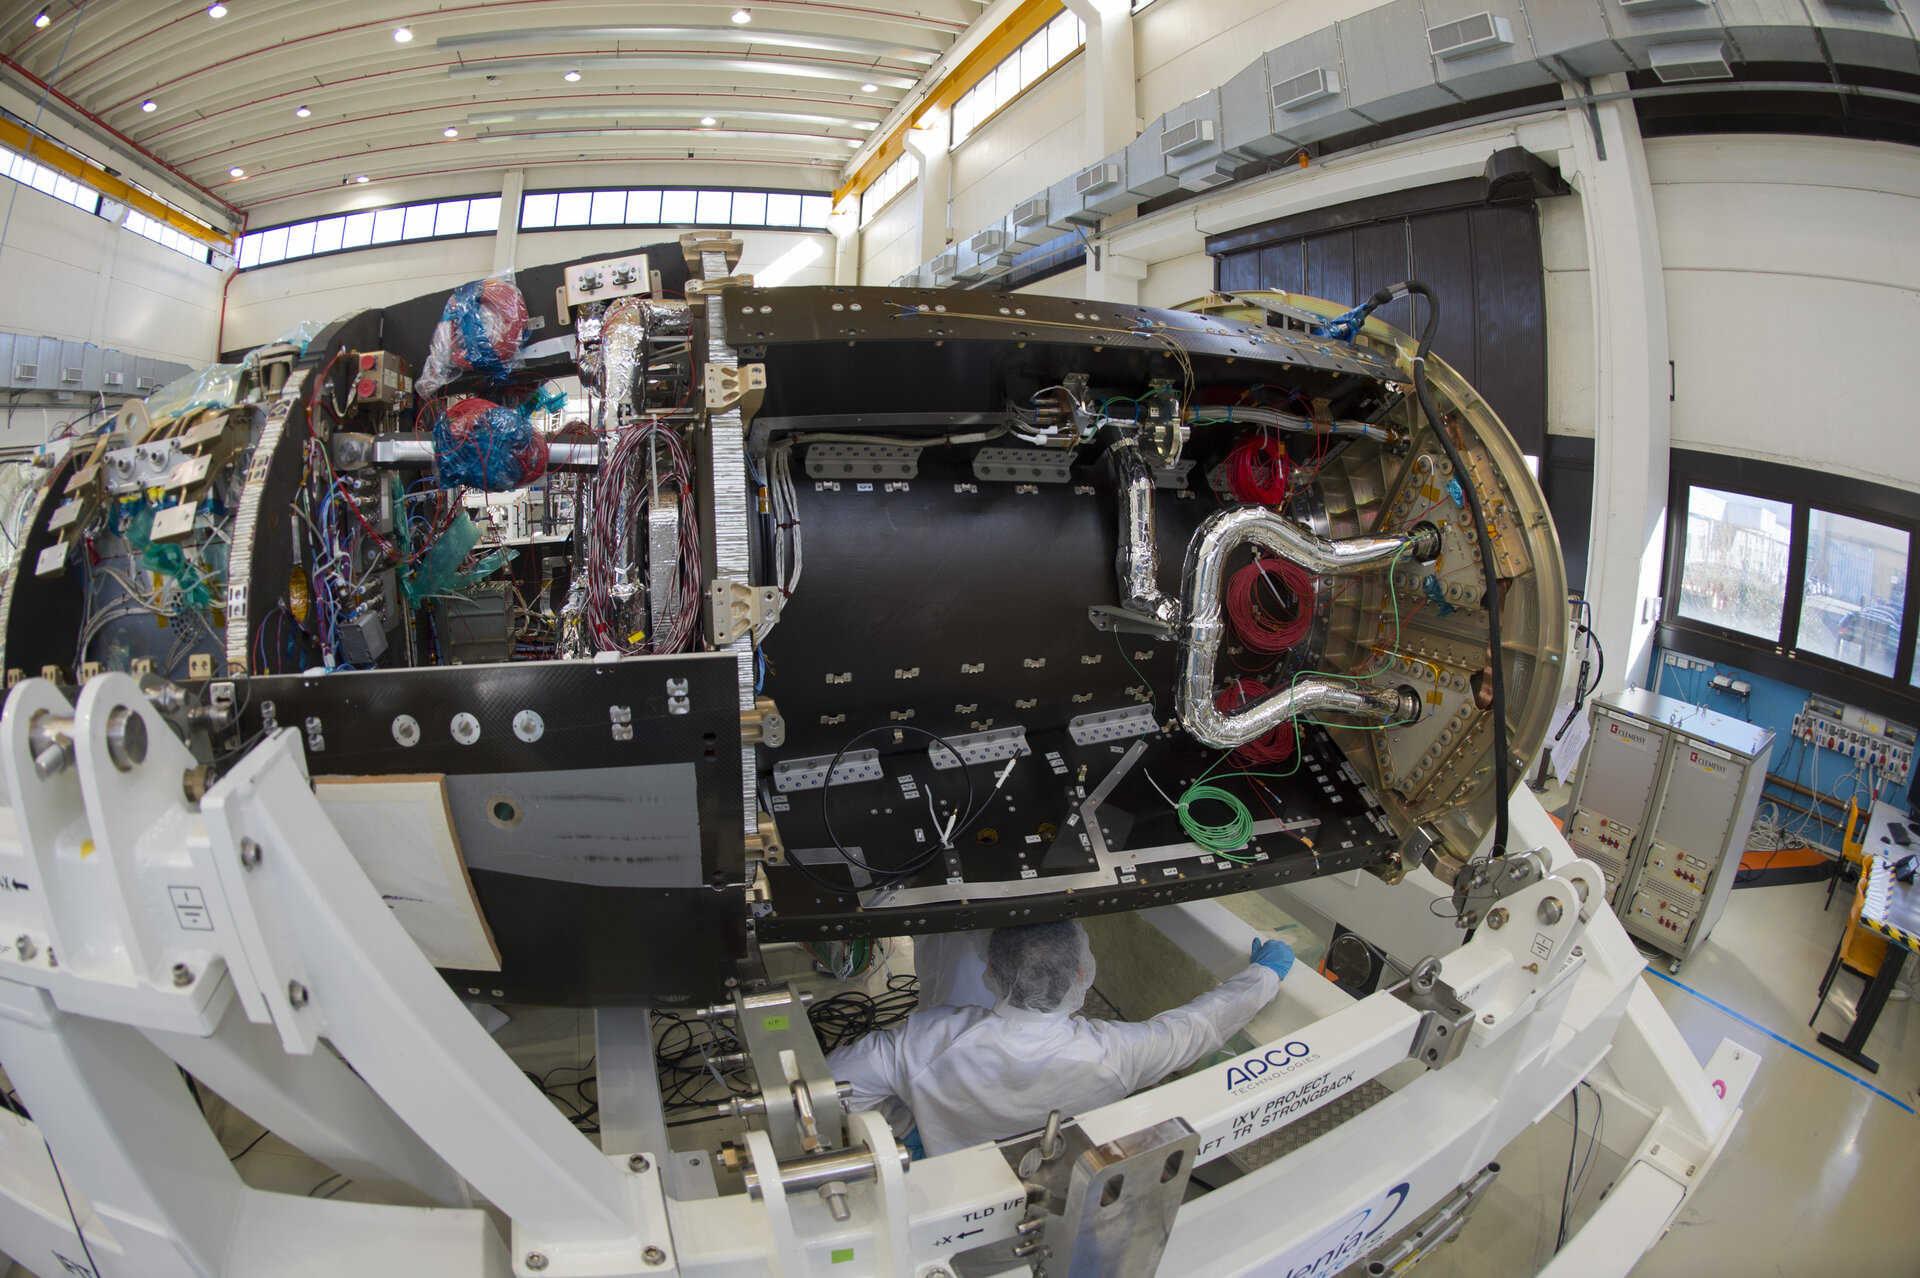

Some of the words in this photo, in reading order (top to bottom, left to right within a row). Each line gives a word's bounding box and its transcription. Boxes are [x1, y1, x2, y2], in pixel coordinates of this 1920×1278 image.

[1618, 729, 1647, 744] CLEMESSY
[1697, 757, 1727, 773] CLEMESSY
[1227, 1041, 1310, 1091] APCO
[1231, 1053, 1321, 1097] TECHNOLOGIES
[1232, 1107, 1261, 1130] IXV
[1264, 1072, 1332, 1114] PROJECT
[1232, 1123, 1253, 1141] TR
[1260, 1070, 1356, 1127] STRONGBACK
[962, 1207, 995, 1222] TLD
[1003, 1197, 1025, 1211] I/F
[932, 1235, 953, 1247] +X
